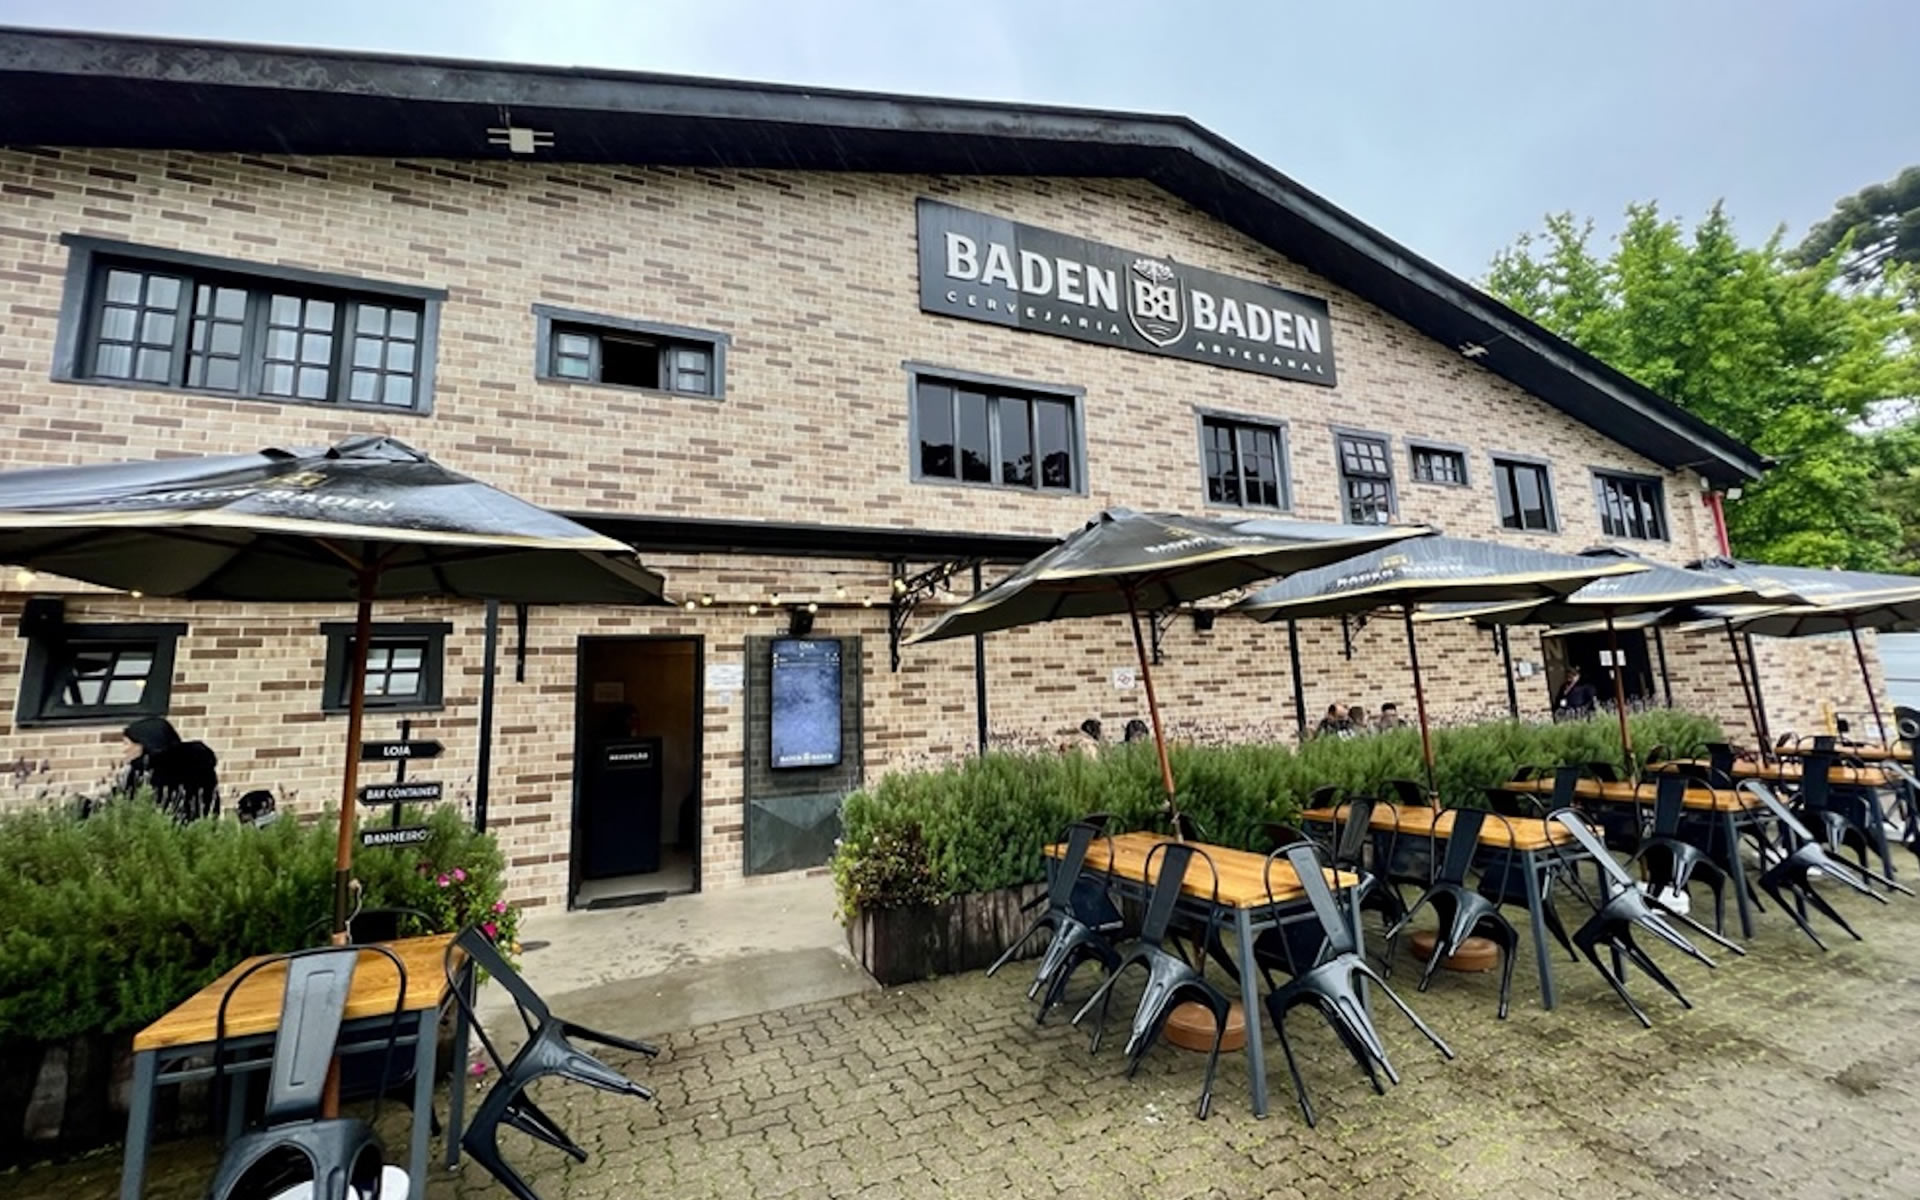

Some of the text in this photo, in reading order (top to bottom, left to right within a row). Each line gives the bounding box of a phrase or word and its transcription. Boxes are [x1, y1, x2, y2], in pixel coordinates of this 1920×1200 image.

[944, 231, 1119, 311] BADEN
[1190, 289, 1321, 353] BADEN
[946, 290, 1324, 375] CERVEJARIA ARTESANAL
[383, 745, 411, 757] LOJA
[366, 785, 440, 800] BAR CONTAINER
